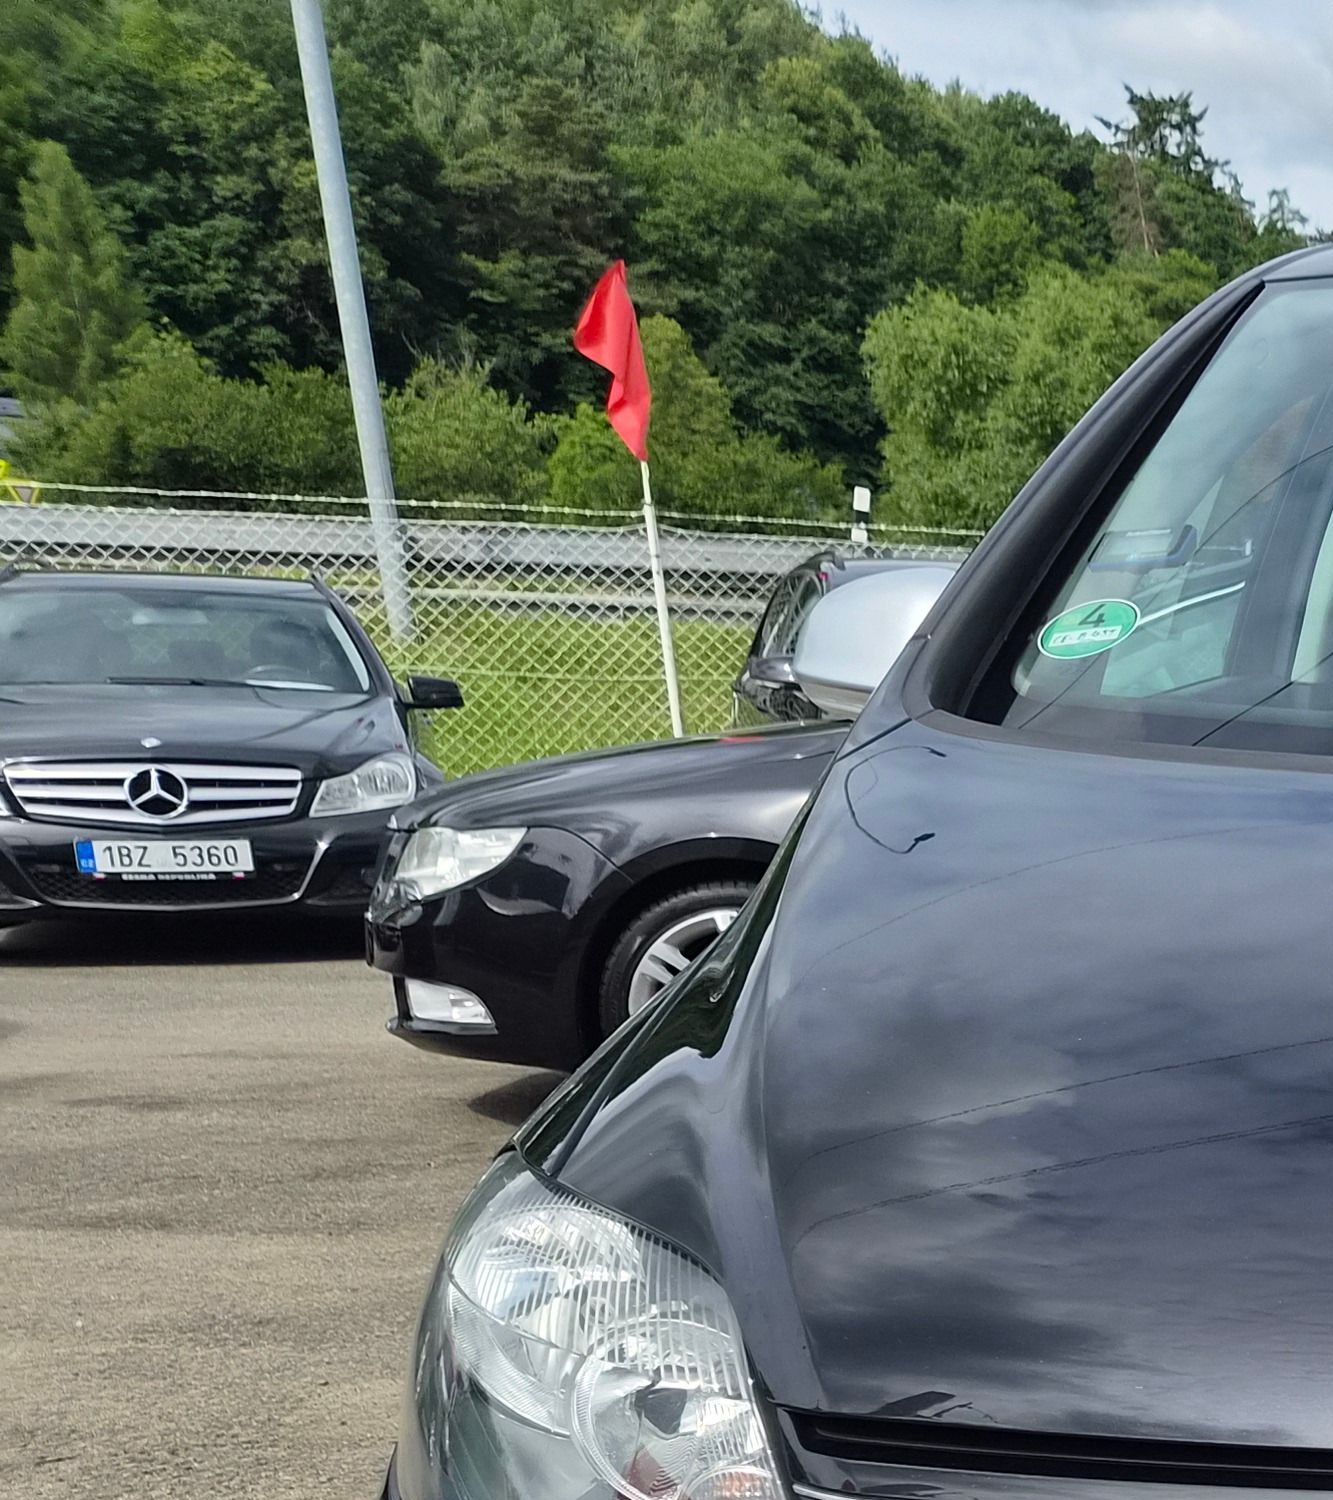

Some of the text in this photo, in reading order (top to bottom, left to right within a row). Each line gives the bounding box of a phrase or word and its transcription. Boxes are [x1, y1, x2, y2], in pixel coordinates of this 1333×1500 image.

[1078, 603, 1105, 628] 4
[103, 845, 239, 868] 1BZ 5360
